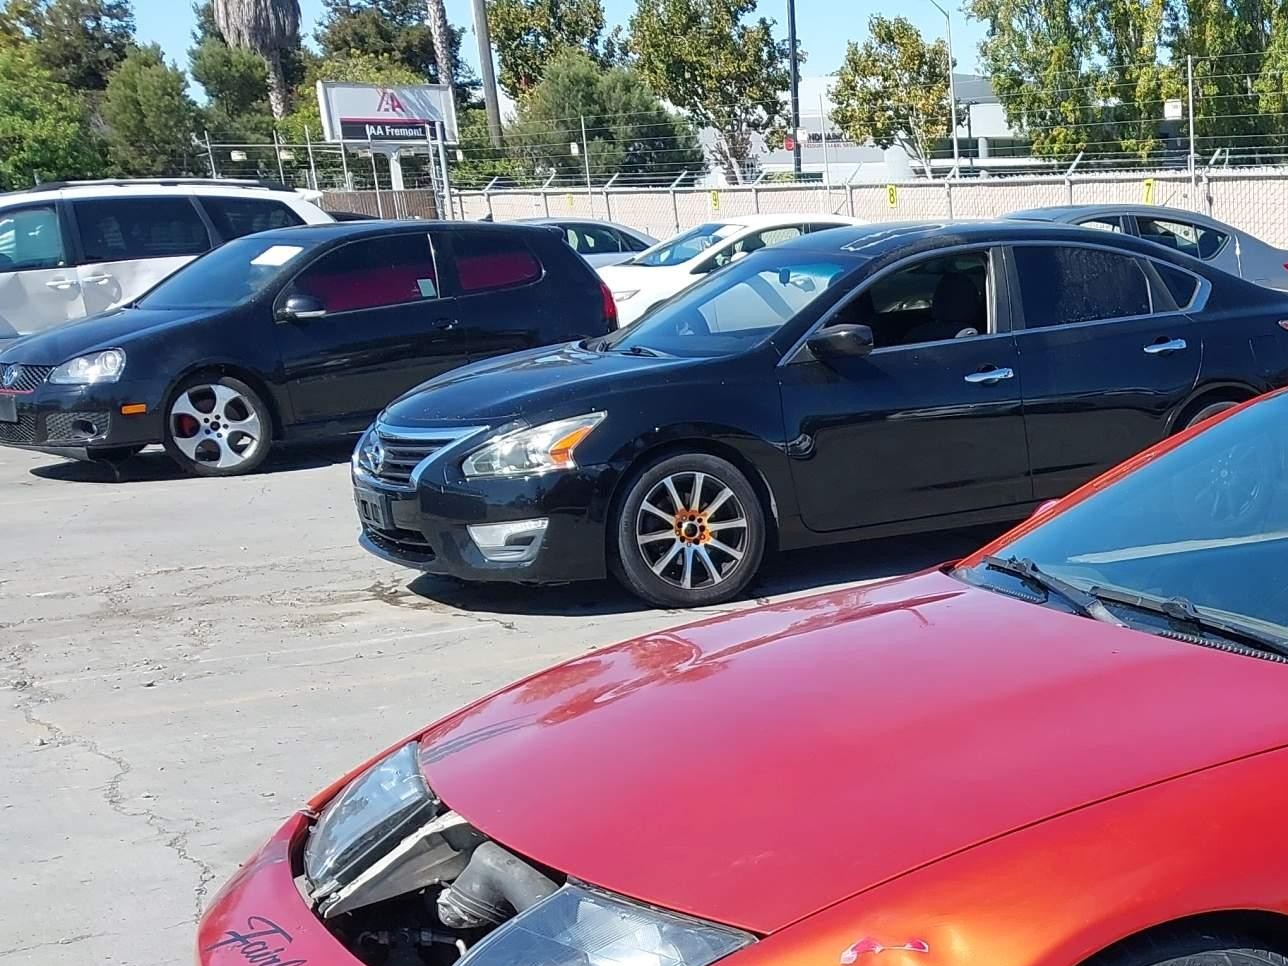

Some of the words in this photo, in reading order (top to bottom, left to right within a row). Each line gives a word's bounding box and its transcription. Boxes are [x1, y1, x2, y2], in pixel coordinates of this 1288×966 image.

[367, 124, 384, 136] AA
[385, 125, 423, 137] Fremont
[712, 191, 718, 206] 9
[889, 187, 896, 204] 8
[1145, 183, 1152, 203] 7
